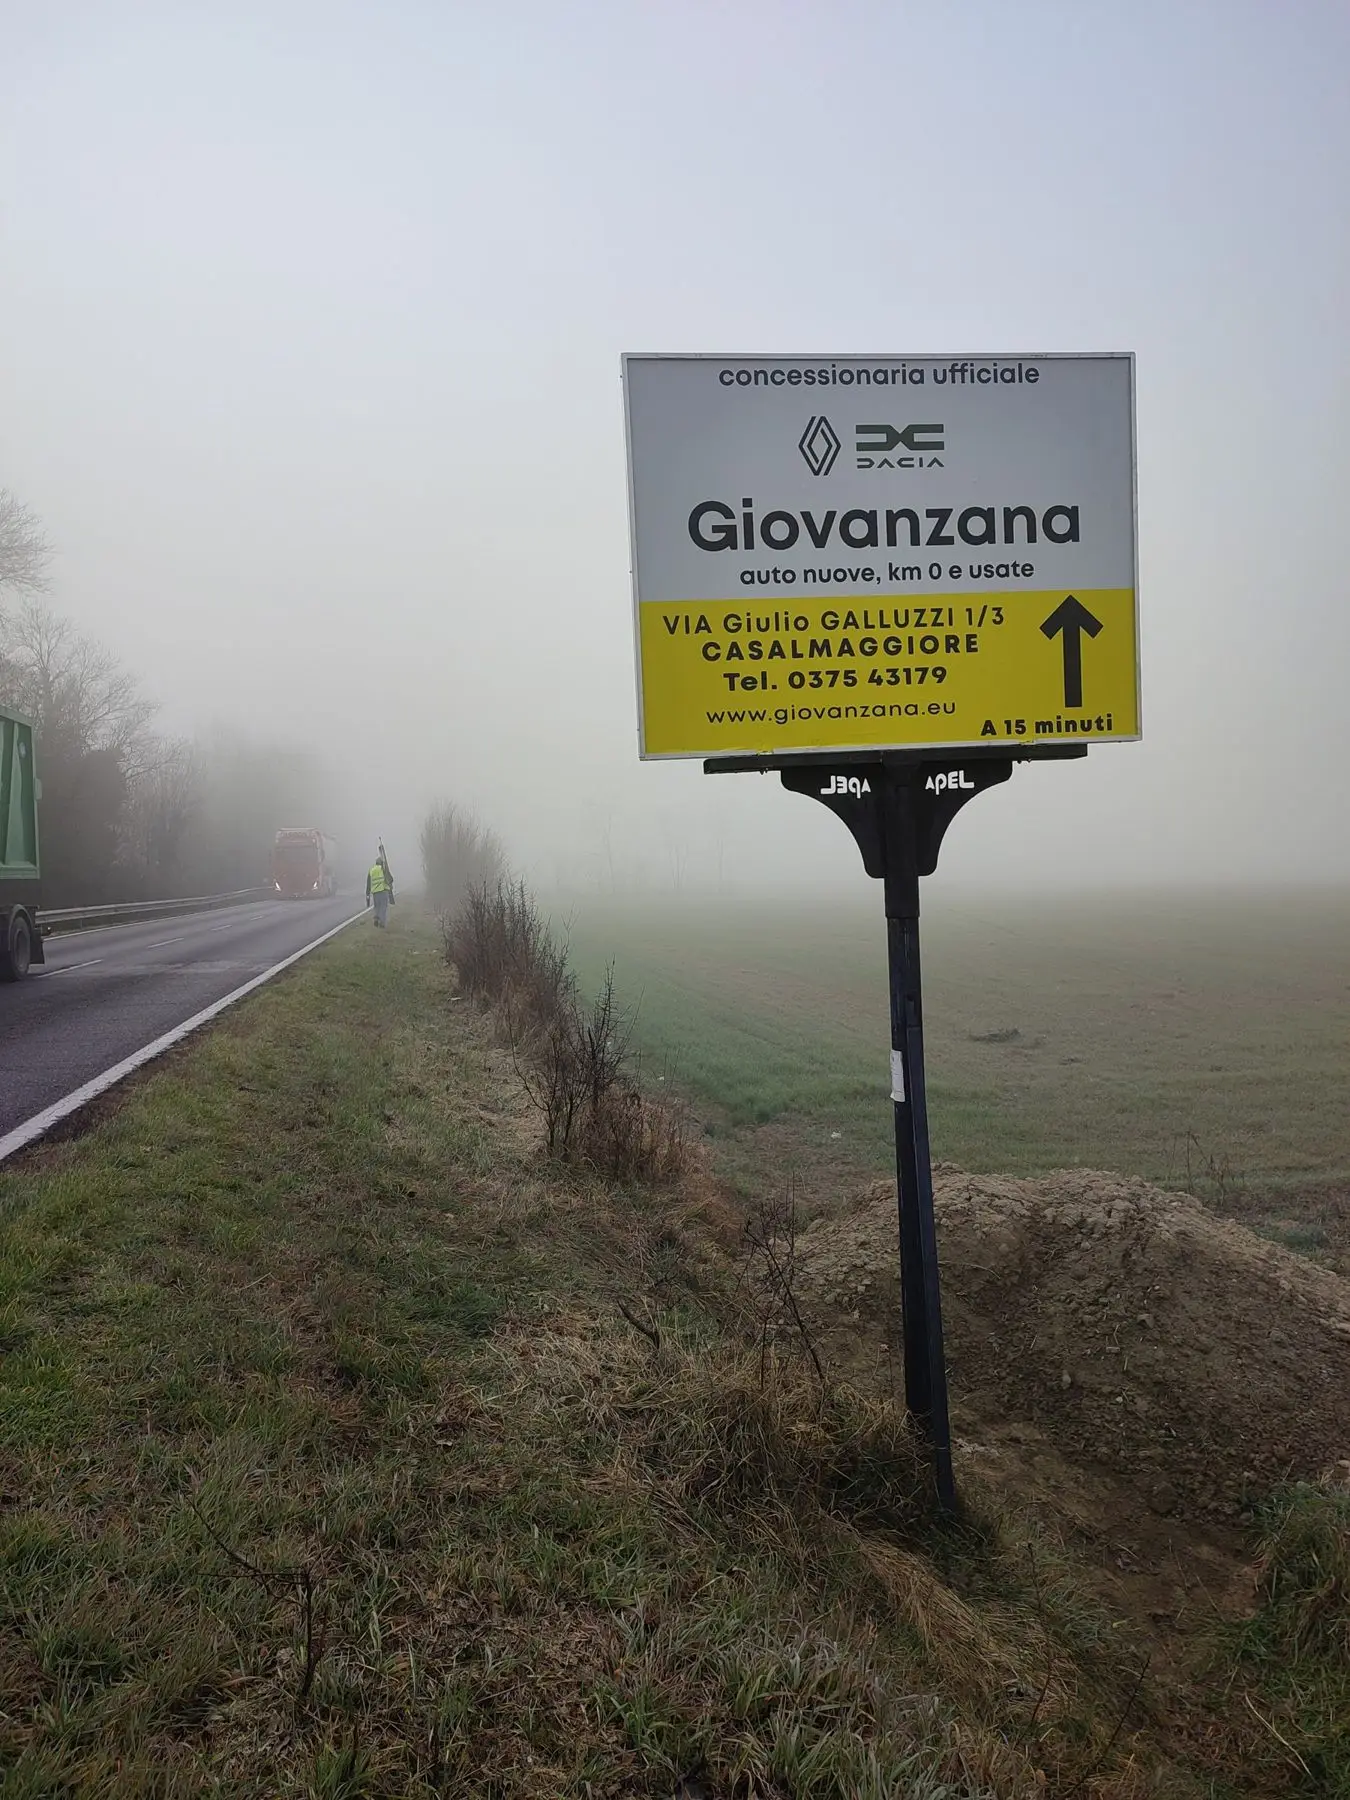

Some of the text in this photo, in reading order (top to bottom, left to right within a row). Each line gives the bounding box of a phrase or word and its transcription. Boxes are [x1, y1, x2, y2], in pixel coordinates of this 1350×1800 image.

[718, 362, 1040, 387] concessionaria ufficiale
[856, 456, 945, 470] DACIA
[687, 497, 1080, 552] Giovanzana
[739, 560, 1035, 585] auto nuove, km 0 e usate
[662, 604, 1004, 636] VIA Giulio GALLUZZI 1/3
[701, 633, 979, 662] CASALMAGGIORE
[722, 666, 947, 692] Tel. 0375 43179
[706, 702, 956, 725] www.giovanzana.eu
[980, 713, 1113, 737] A 15 minuti
